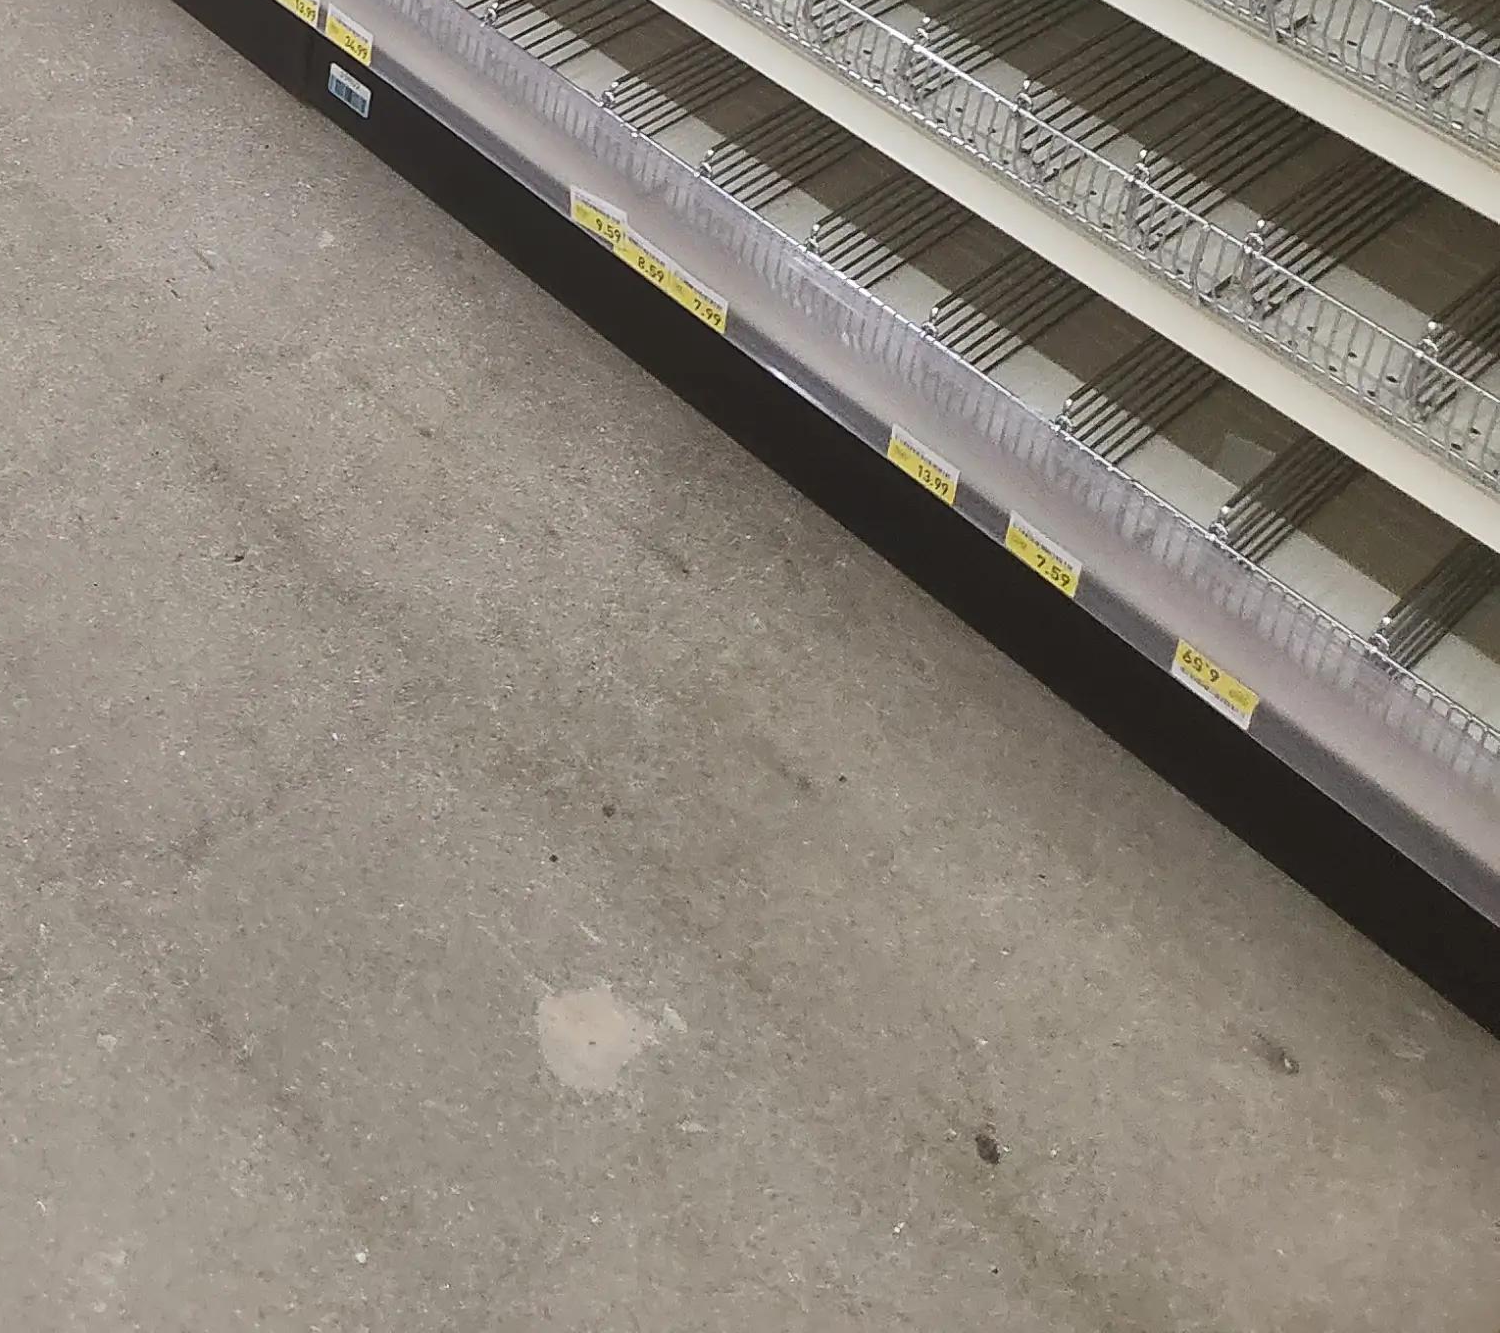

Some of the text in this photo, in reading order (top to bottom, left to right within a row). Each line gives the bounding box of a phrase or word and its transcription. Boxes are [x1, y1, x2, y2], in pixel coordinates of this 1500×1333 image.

[595, 217, 622, 244] 9.59
[637, 255, 665, 283] 8.59
[693, 298, 722, 326] 7.99
[916, 464, 950, 496] 13.99
[1036, 553, 1071, 588] 7.59
[1182, 649, 1221, 683] 6.59
